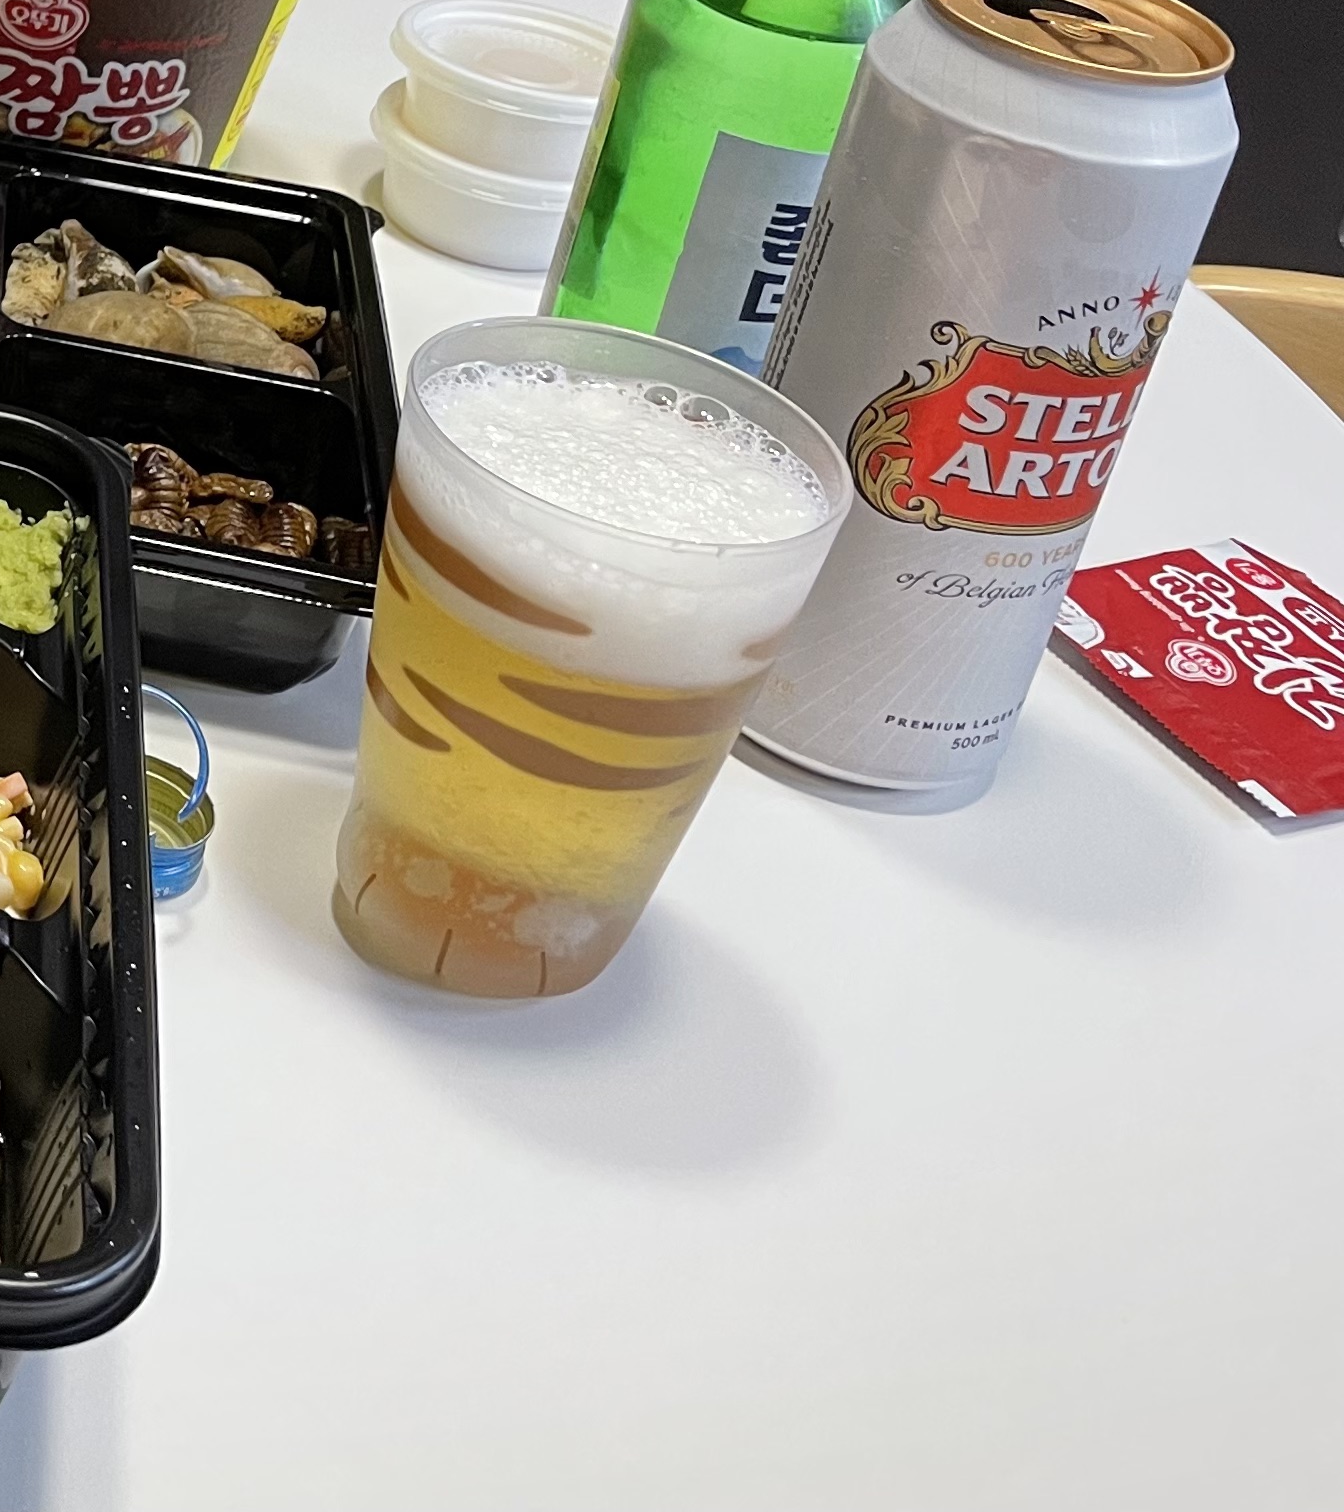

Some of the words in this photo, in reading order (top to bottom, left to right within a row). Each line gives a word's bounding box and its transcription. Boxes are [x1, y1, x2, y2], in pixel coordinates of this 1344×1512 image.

[11, 7, 70, 35] 오뚜기
[1037, 296, 1120, 331] ANNO
[929, 440, 1122, 498] ARTO
[984, 551, 1033, 568] 600
[1042, 538, 1085, 566] YEAR
[896, 569, 936, 591] of
[925, 573, 1037, 609] Belgian
[1150, 565, 1344, 730] 진짬뽕
[1183, 645, 1227, 678] 오뚜기
[884, 714, 967, 732] PREMIUM
[951, 735, 981, 750] 500
